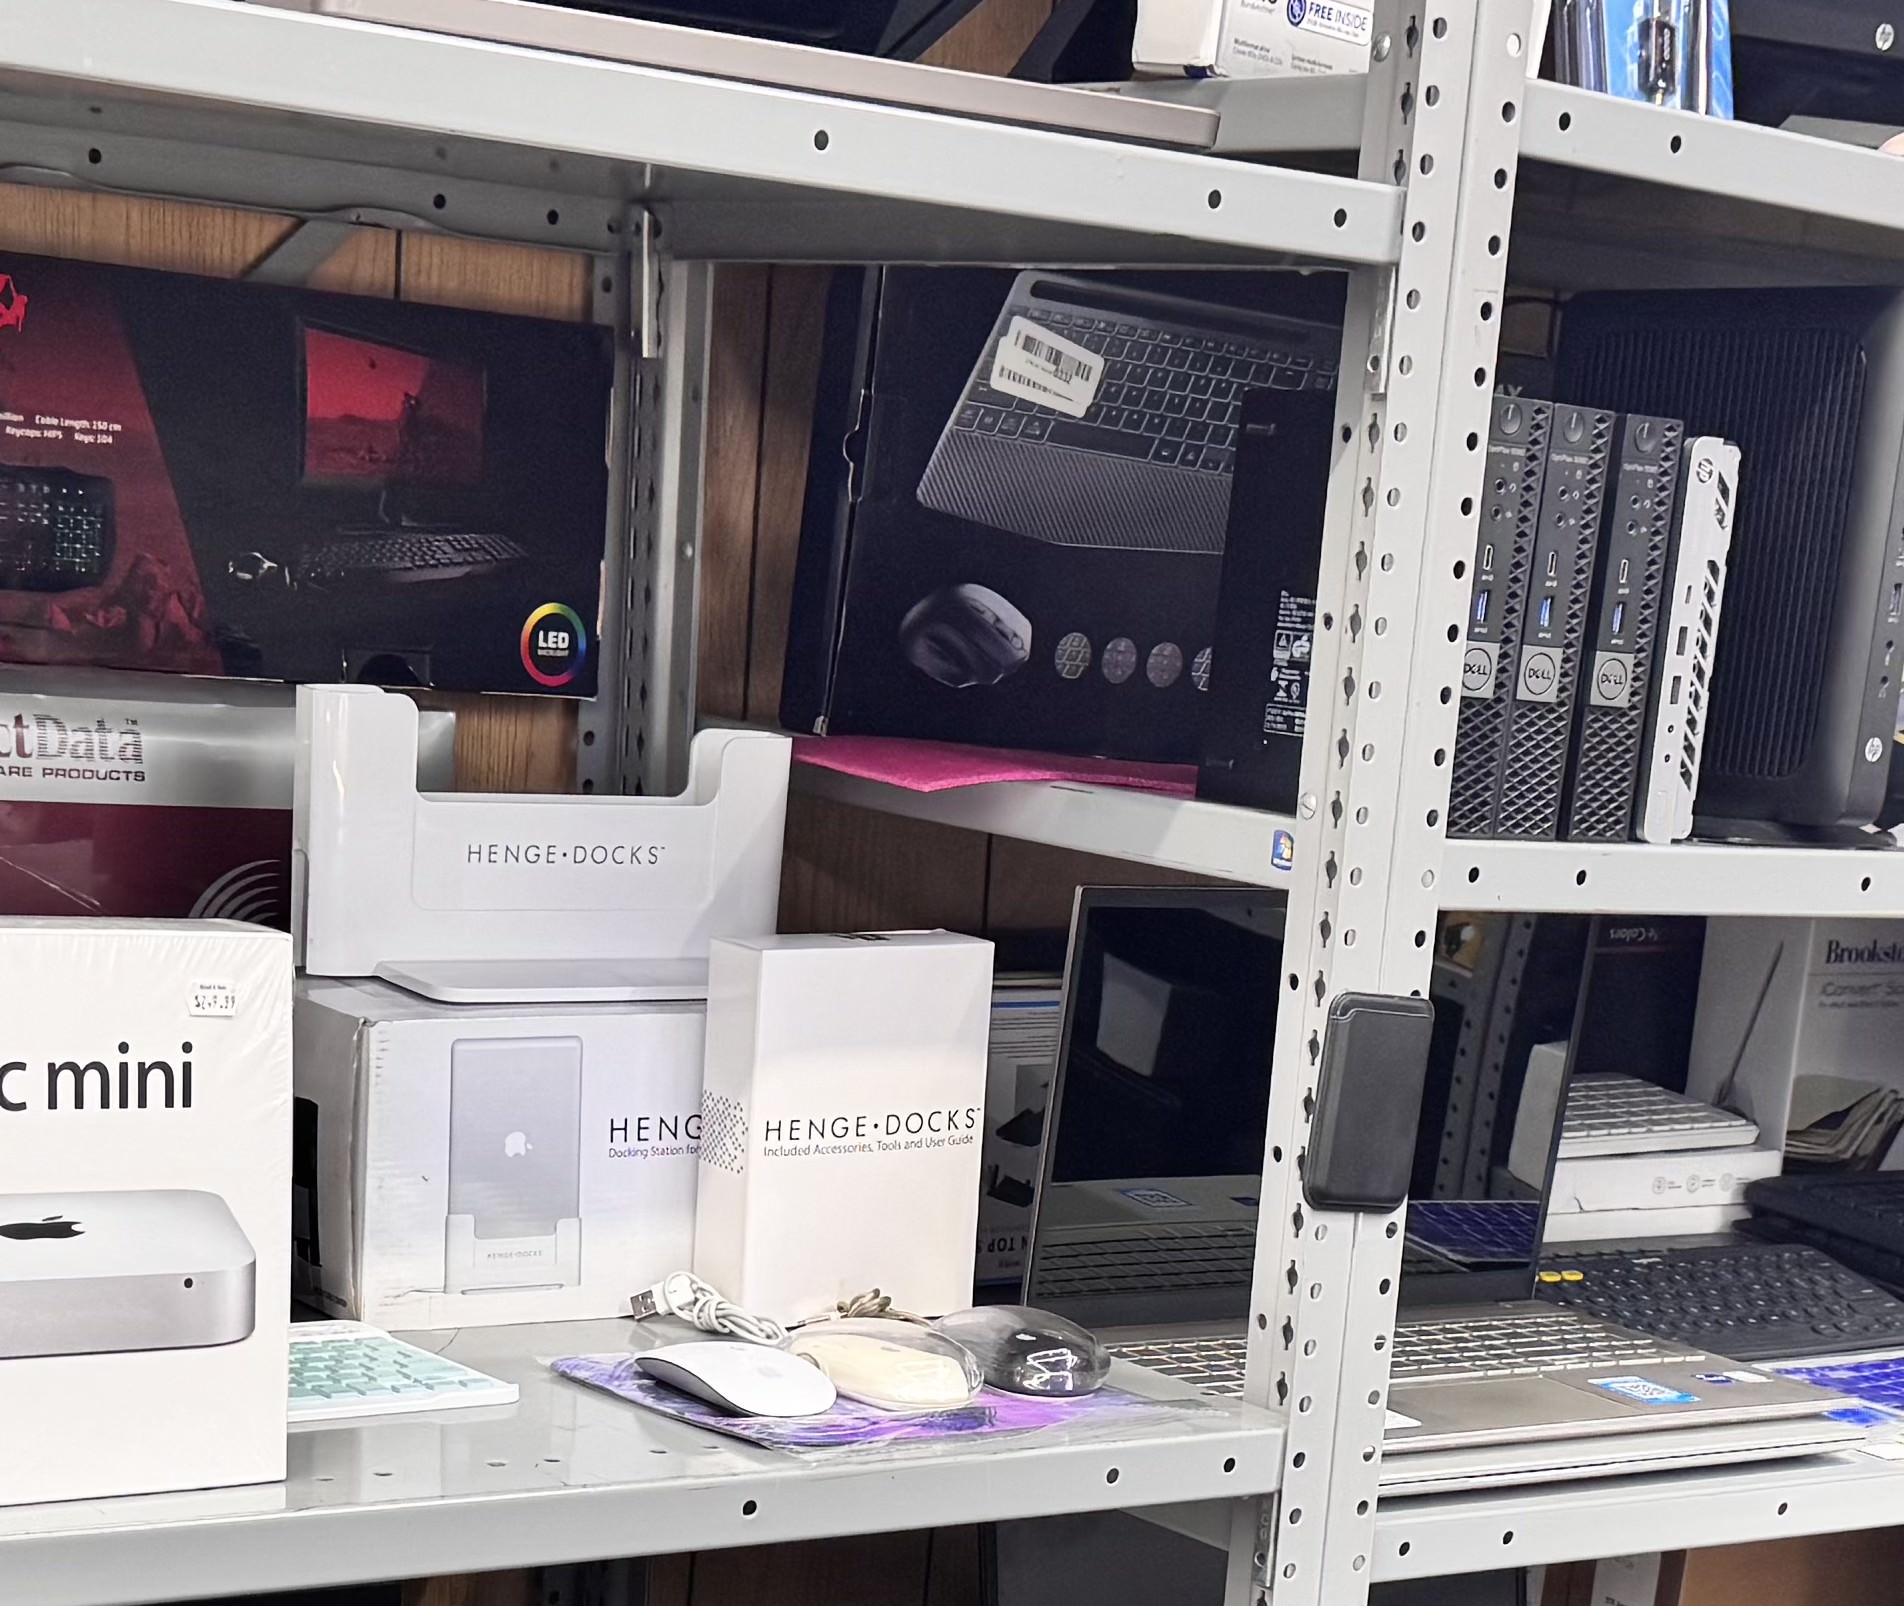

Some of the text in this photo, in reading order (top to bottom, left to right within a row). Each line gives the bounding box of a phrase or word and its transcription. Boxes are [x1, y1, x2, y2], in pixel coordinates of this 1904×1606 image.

[538, 630, 569, 648] LED
[1528, 668, 1551, 681] DELL
[1601, 672, 1624, 686] DELL
[42, 767, 146, 782] PRODUCTS
[46, 1040, 193, 1110] mini
[609, 1145, 684, 1160] Docking Station
[764, 1145, 810, 1157] Included
[877, 1139, 901, 1152] Tools
[905, 1138, 922, 1150] and
[925, 1136, 945, 1148] User
[948, 1134, 974, 1147] Guide
